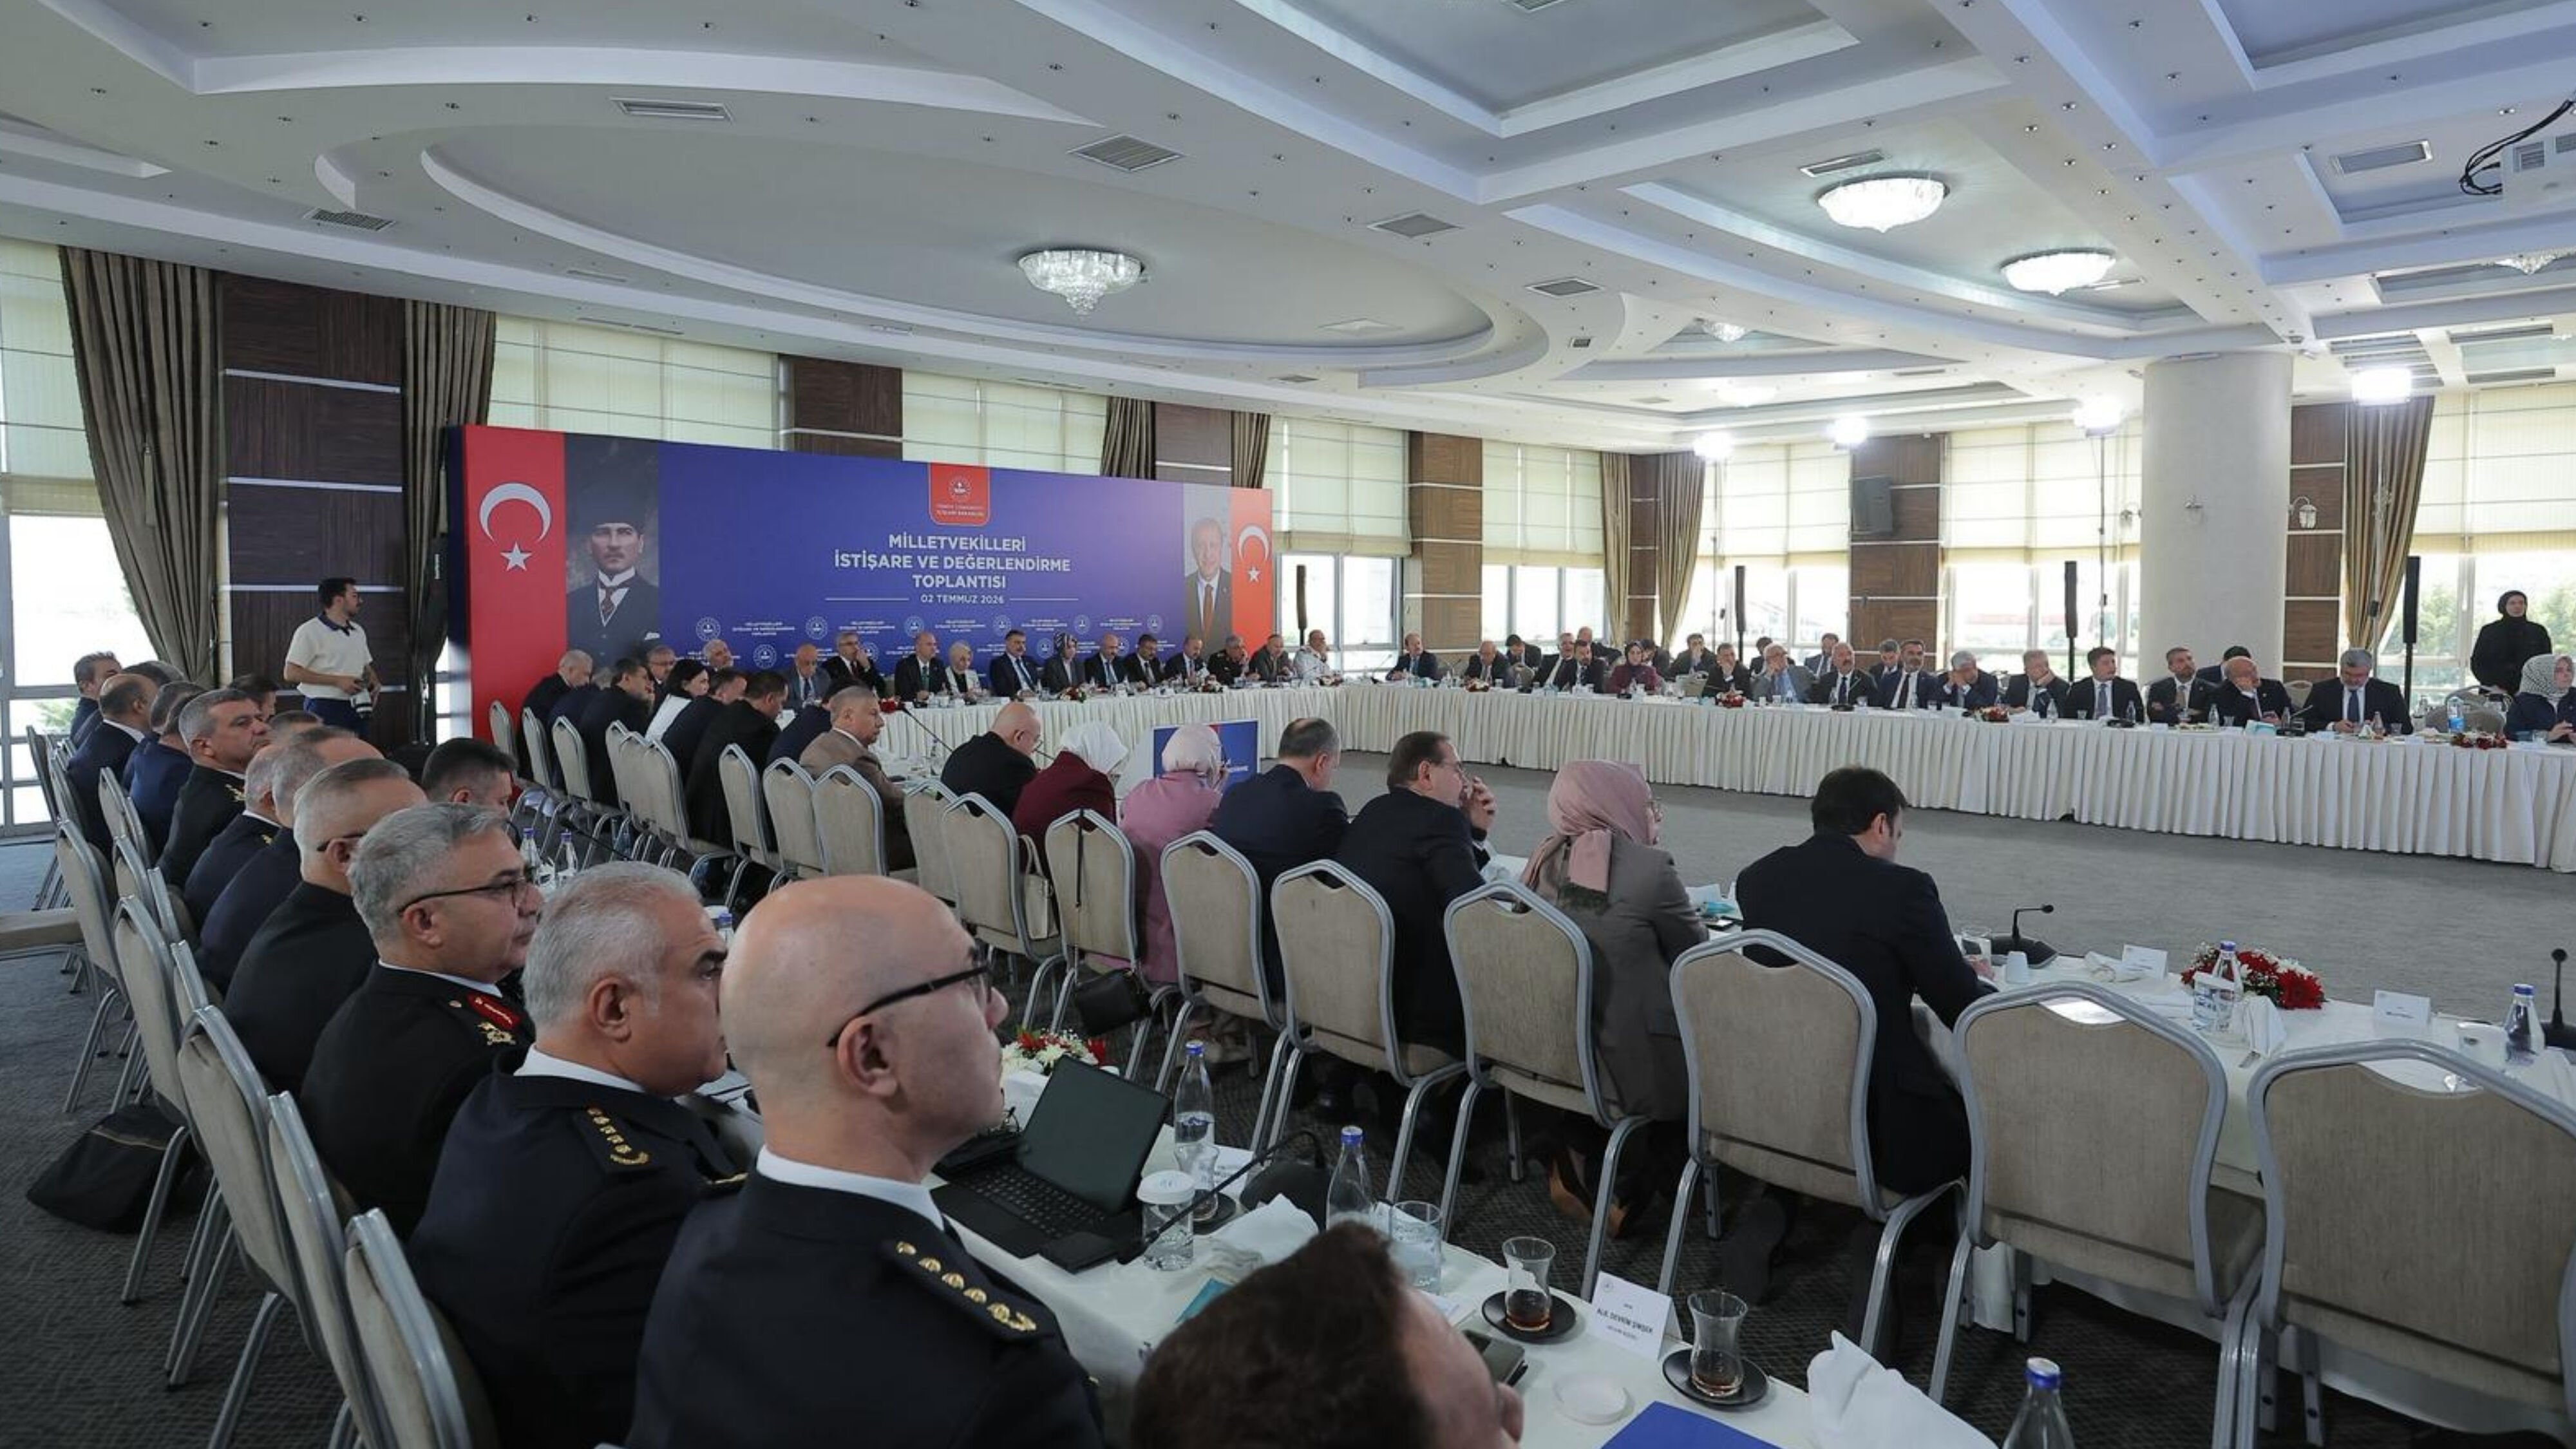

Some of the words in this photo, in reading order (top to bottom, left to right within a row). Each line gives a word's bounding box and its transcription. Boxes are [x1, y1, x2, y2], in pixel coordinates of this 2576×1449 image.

[889, 531, 1026, 552] MİLLETVEKİLLERİ
[835, 549, 913, 571] İSTİŞARE
[917, 555, 940, 569] VE
[943, 553, 1070, 572] DEĞERLENDİRME
[912, 574, 1006, 589] TOPLANTISI
[920, 594, 934, 603] 02
[936, 594, 978, 603] TEMMUZ
[981, 595, 1005, 604] 2026
